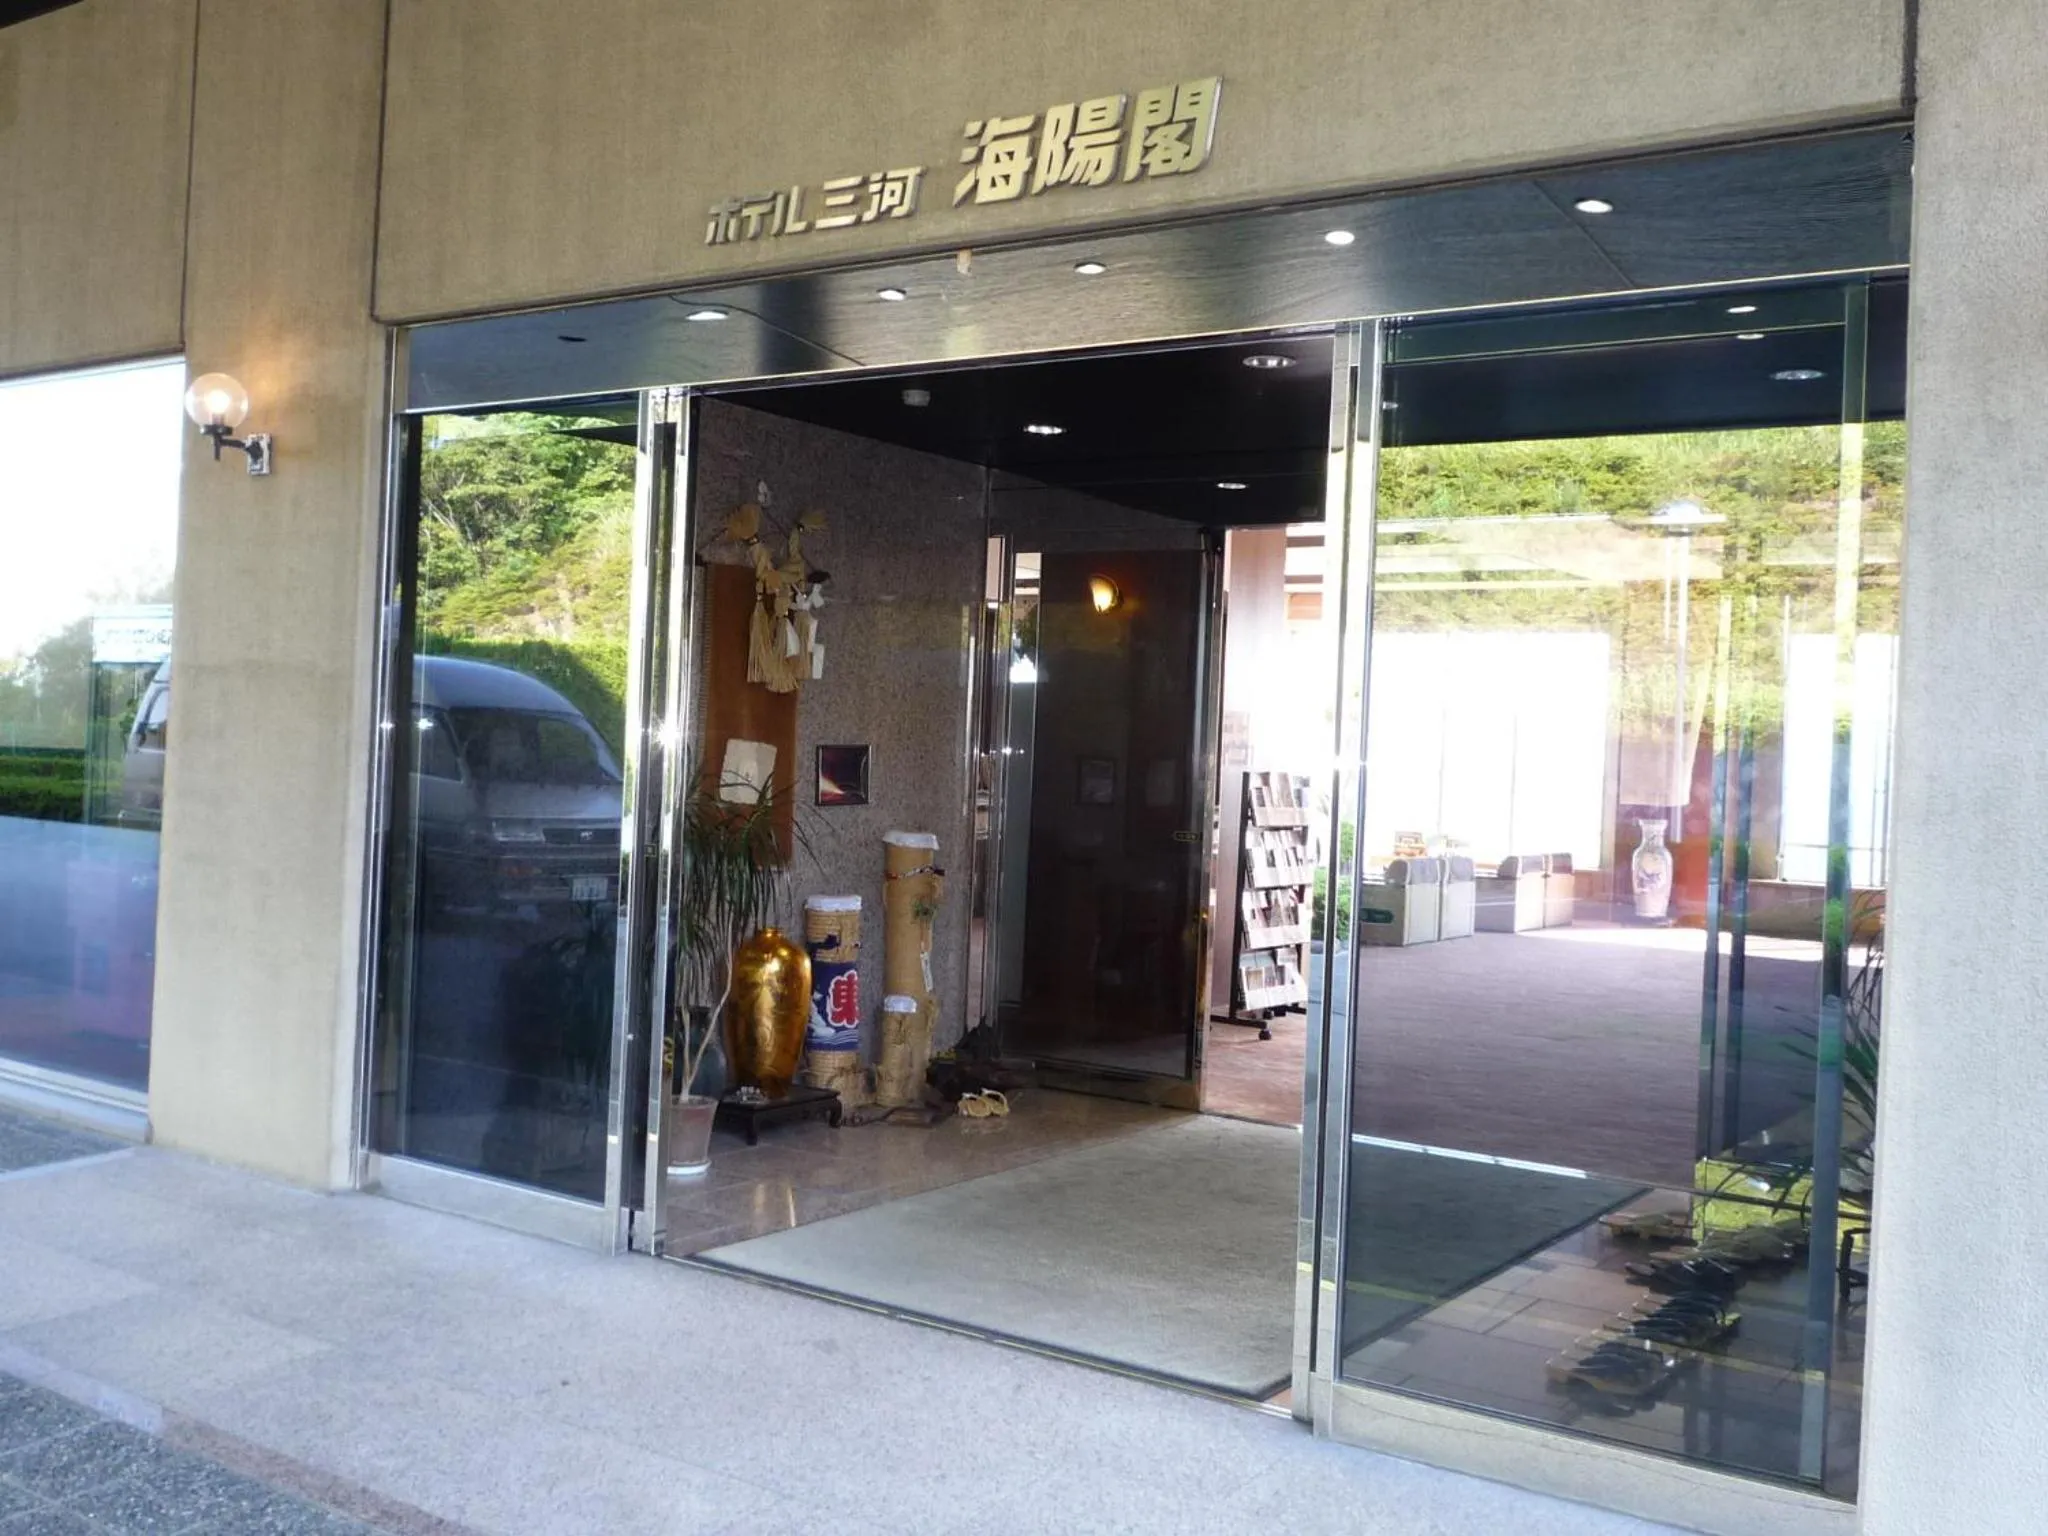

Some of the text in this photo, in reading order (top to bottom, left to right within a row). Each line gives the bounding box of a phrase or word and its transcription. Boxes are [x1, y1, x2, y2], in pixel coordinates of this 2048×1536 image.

[705, 76, 1222, 244] ホテル三河 海陽閣
